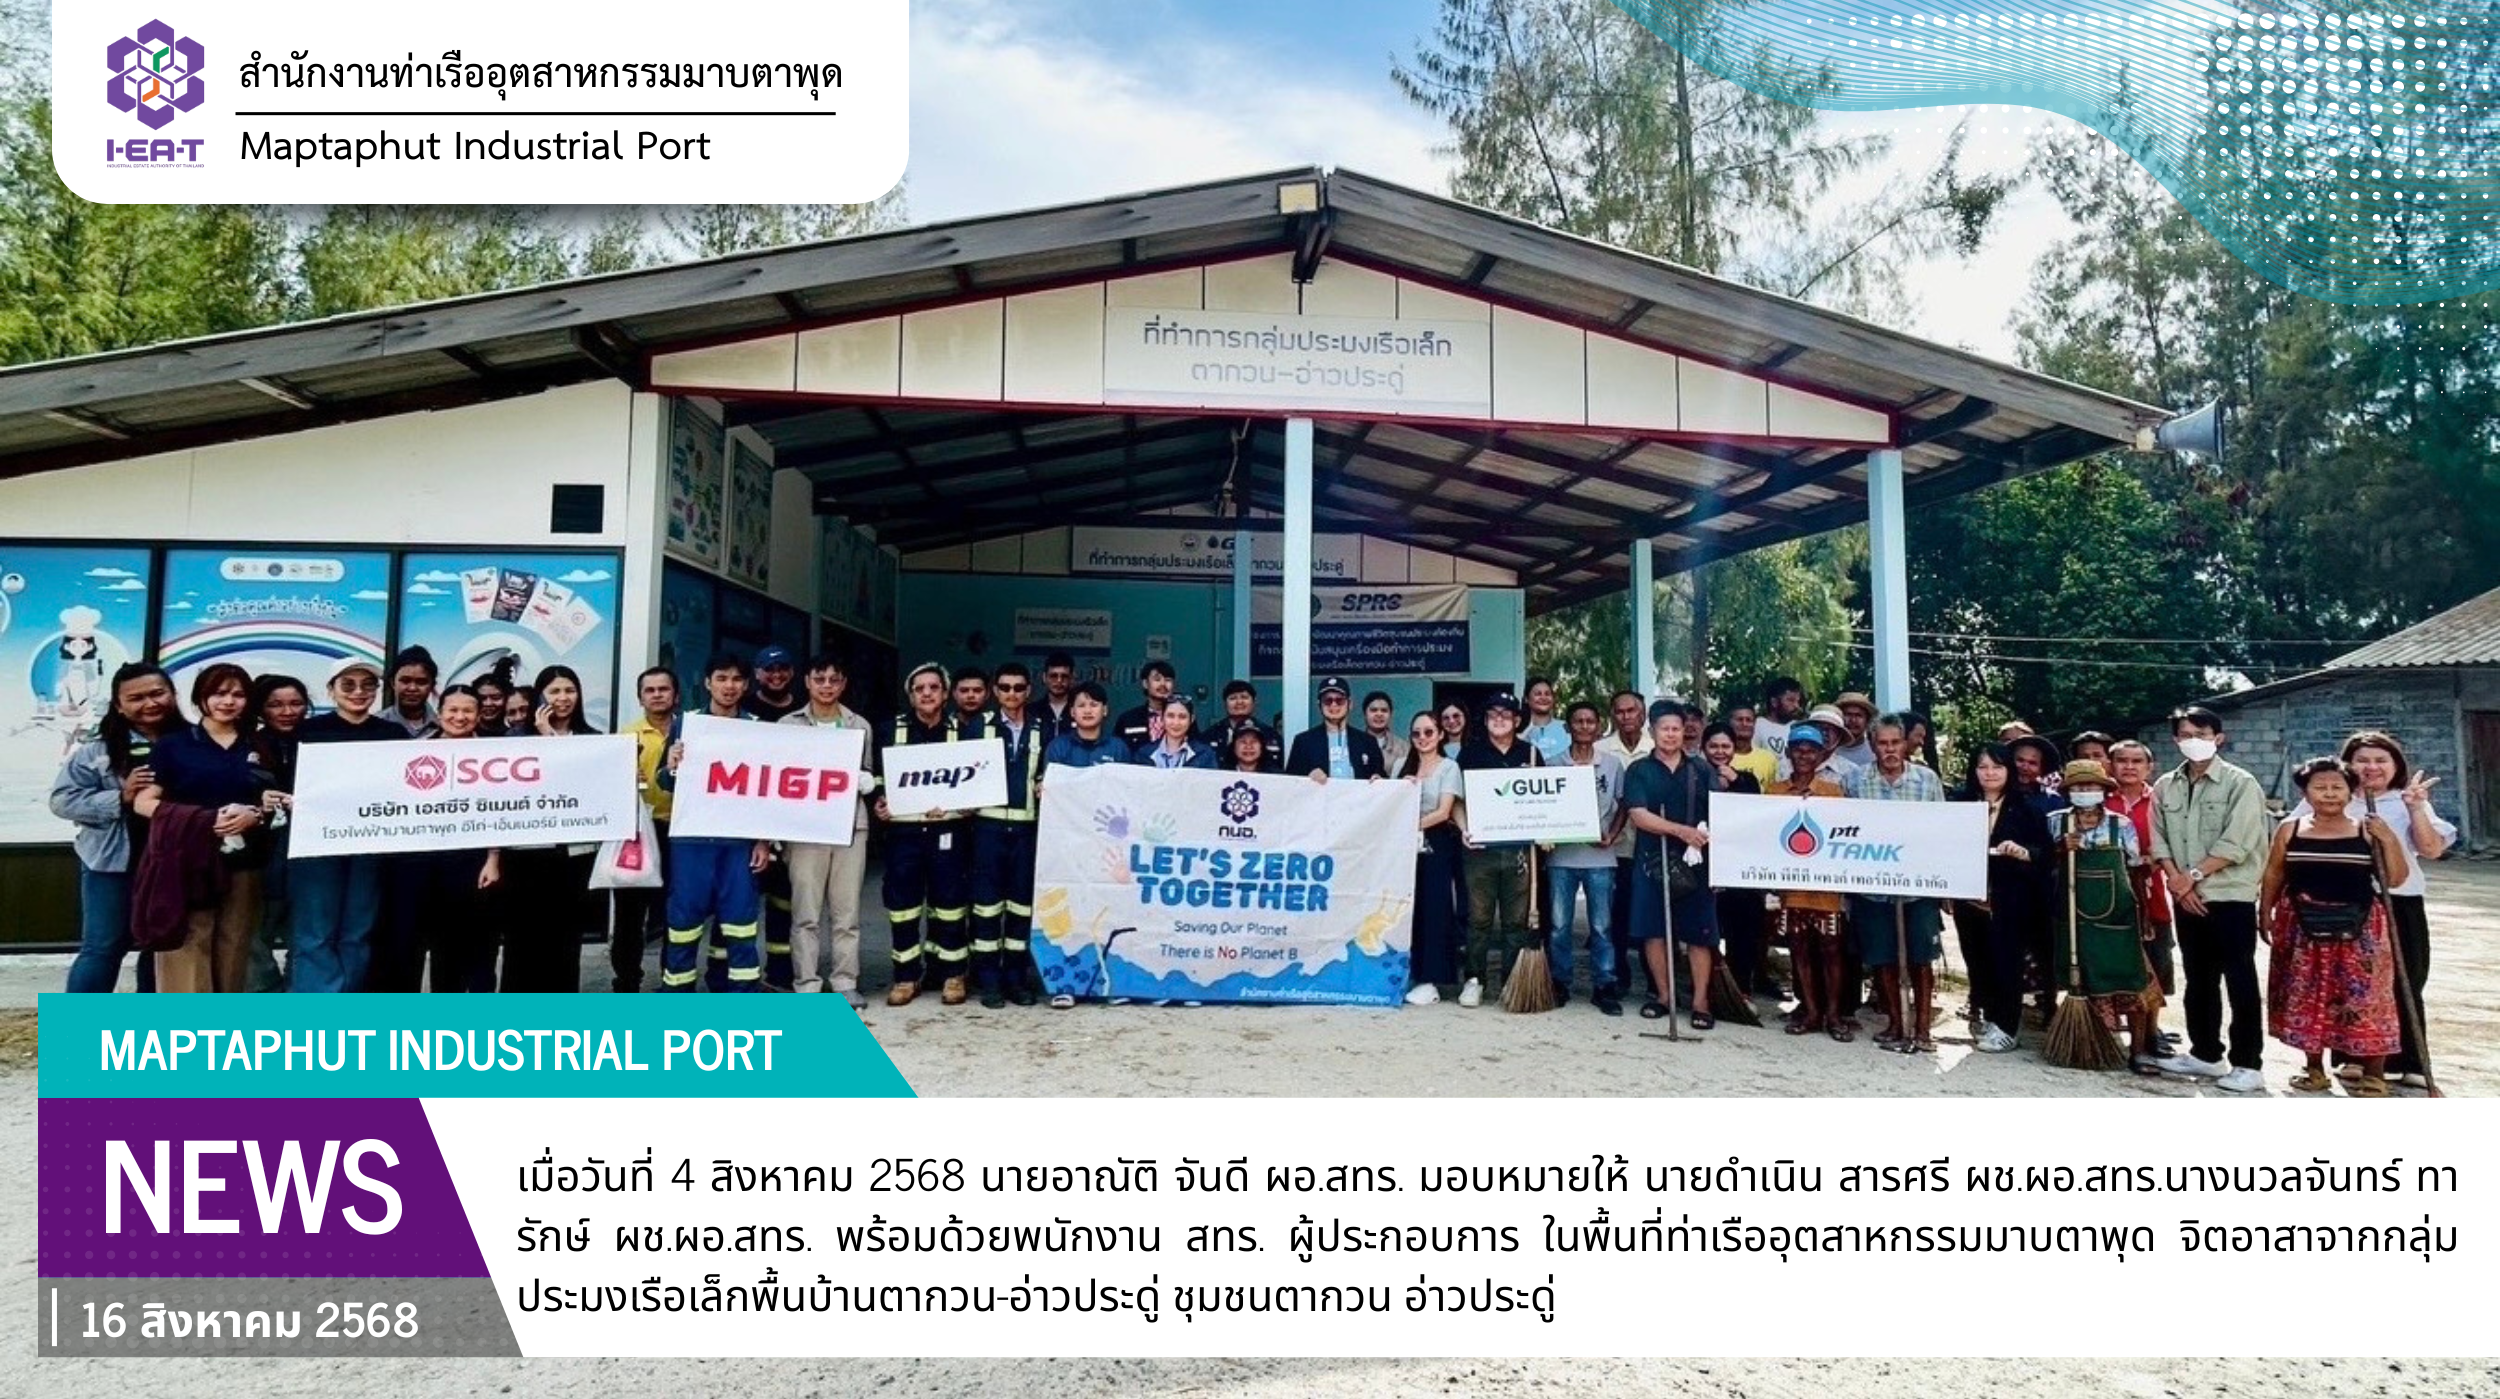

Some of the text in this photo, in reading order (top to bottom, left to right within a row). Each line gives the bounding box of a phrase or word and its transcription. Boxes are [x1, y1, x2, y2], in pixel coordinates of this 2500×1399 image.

[1144, 315, 1452, 357] ที่ทำการกลุ่มประมงเรือเล็ก
[1191, 360, 1404, 395] ตากวน-อ่าวประดู่
[457, 757, 541, 784] SCG
[707, 760, 849, 801] MIGP
[898, 764, 977, 790] map
[1512, 777, 1567, 796] GULF
[358, 794, 580, 818] บริษัท เอสซีจี ซิเมนต์ จำกัด
[1828, 825, 1861, 839] ptt
[1130, 844, 1334, 882] LET'S ZERO
[1827, 842, 1905, 862] TANK
[1741, 866, 1776, 882] บริษัท
[1136, 876, 1329, 912] TOGETHER
[1174, 921, 1288, 936] Saving Our Planet
[1160, 944, 1298, 960] There is No Planet B
